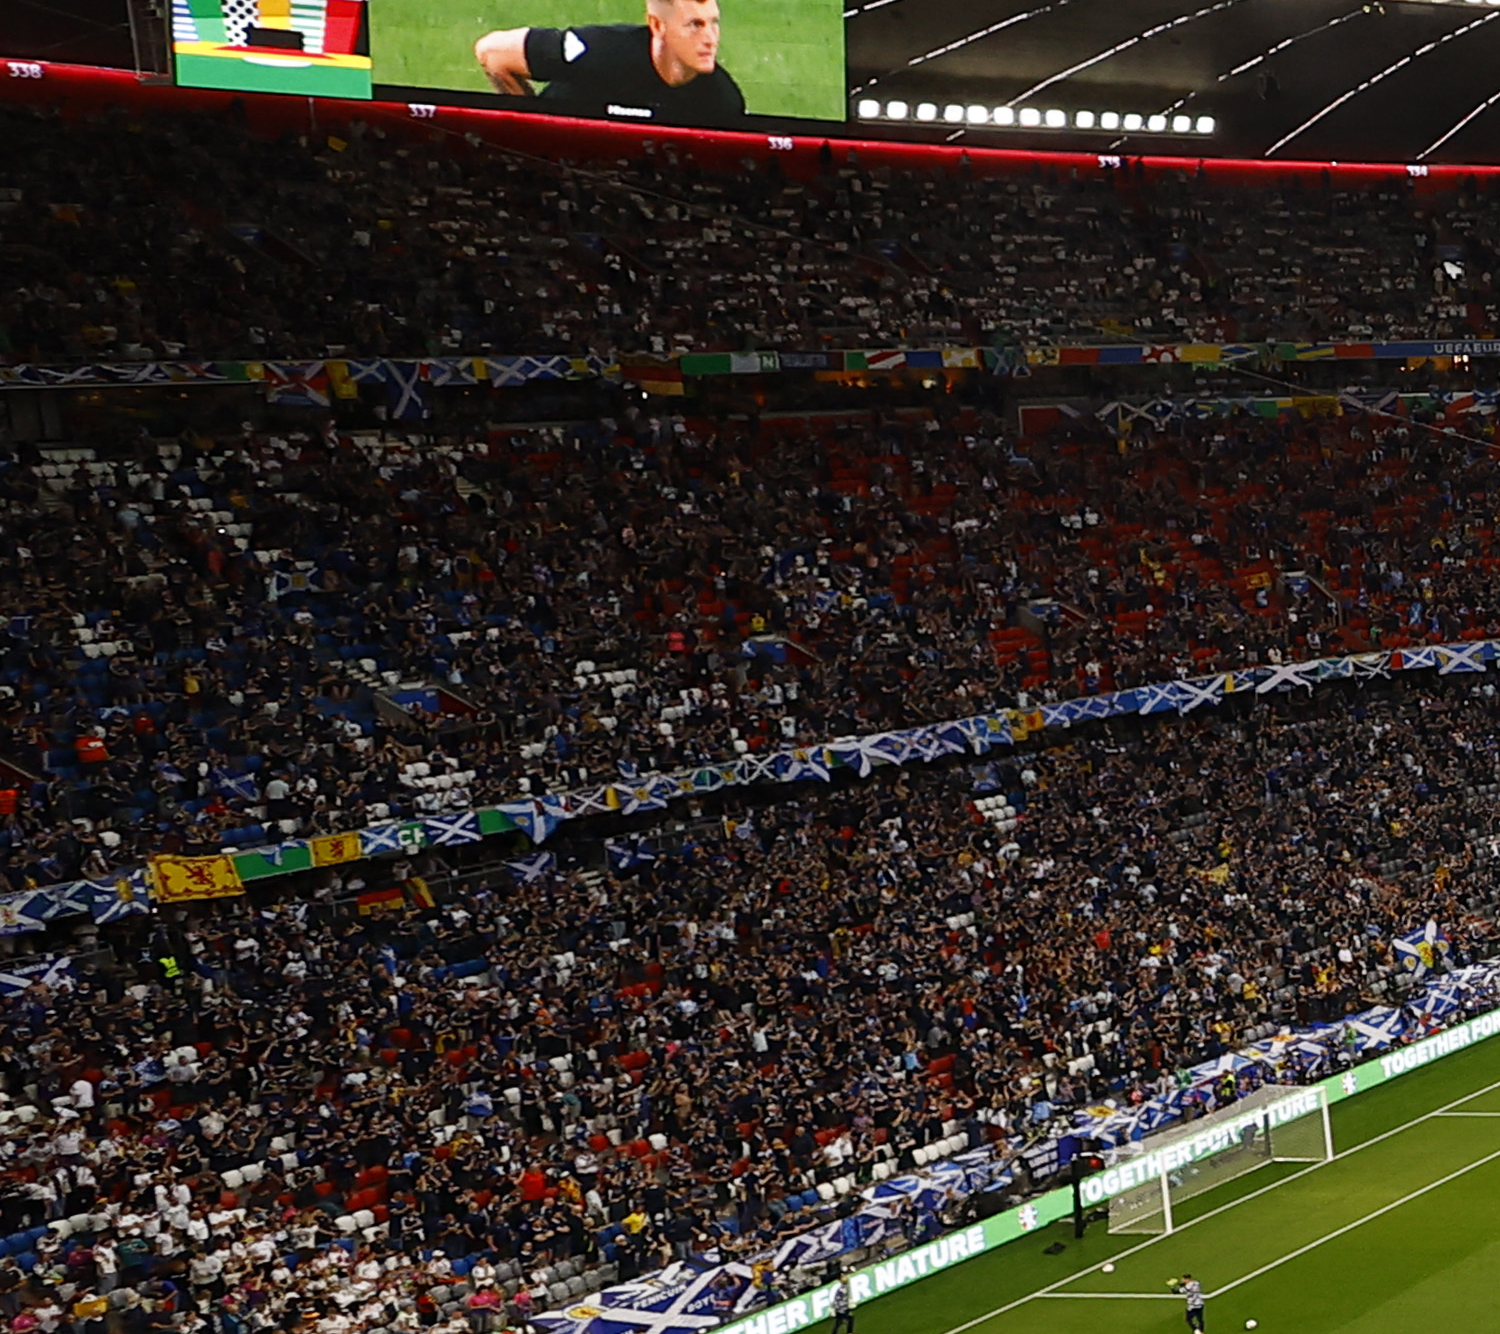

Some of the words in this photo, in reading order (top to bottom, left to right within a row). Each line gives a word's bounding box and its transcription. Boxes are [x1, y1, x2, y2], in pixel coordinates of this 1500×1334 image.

[6, 62, 43, 79] 338
[408, 103, 437, 119] 337
[767, 137, 794, 151] 336
[1380, 1024, 1471, 1079] TOGETHER
[1242, 1093, 1319, 1144] TURE
[874, 1225, 985, 1292] NATURE
